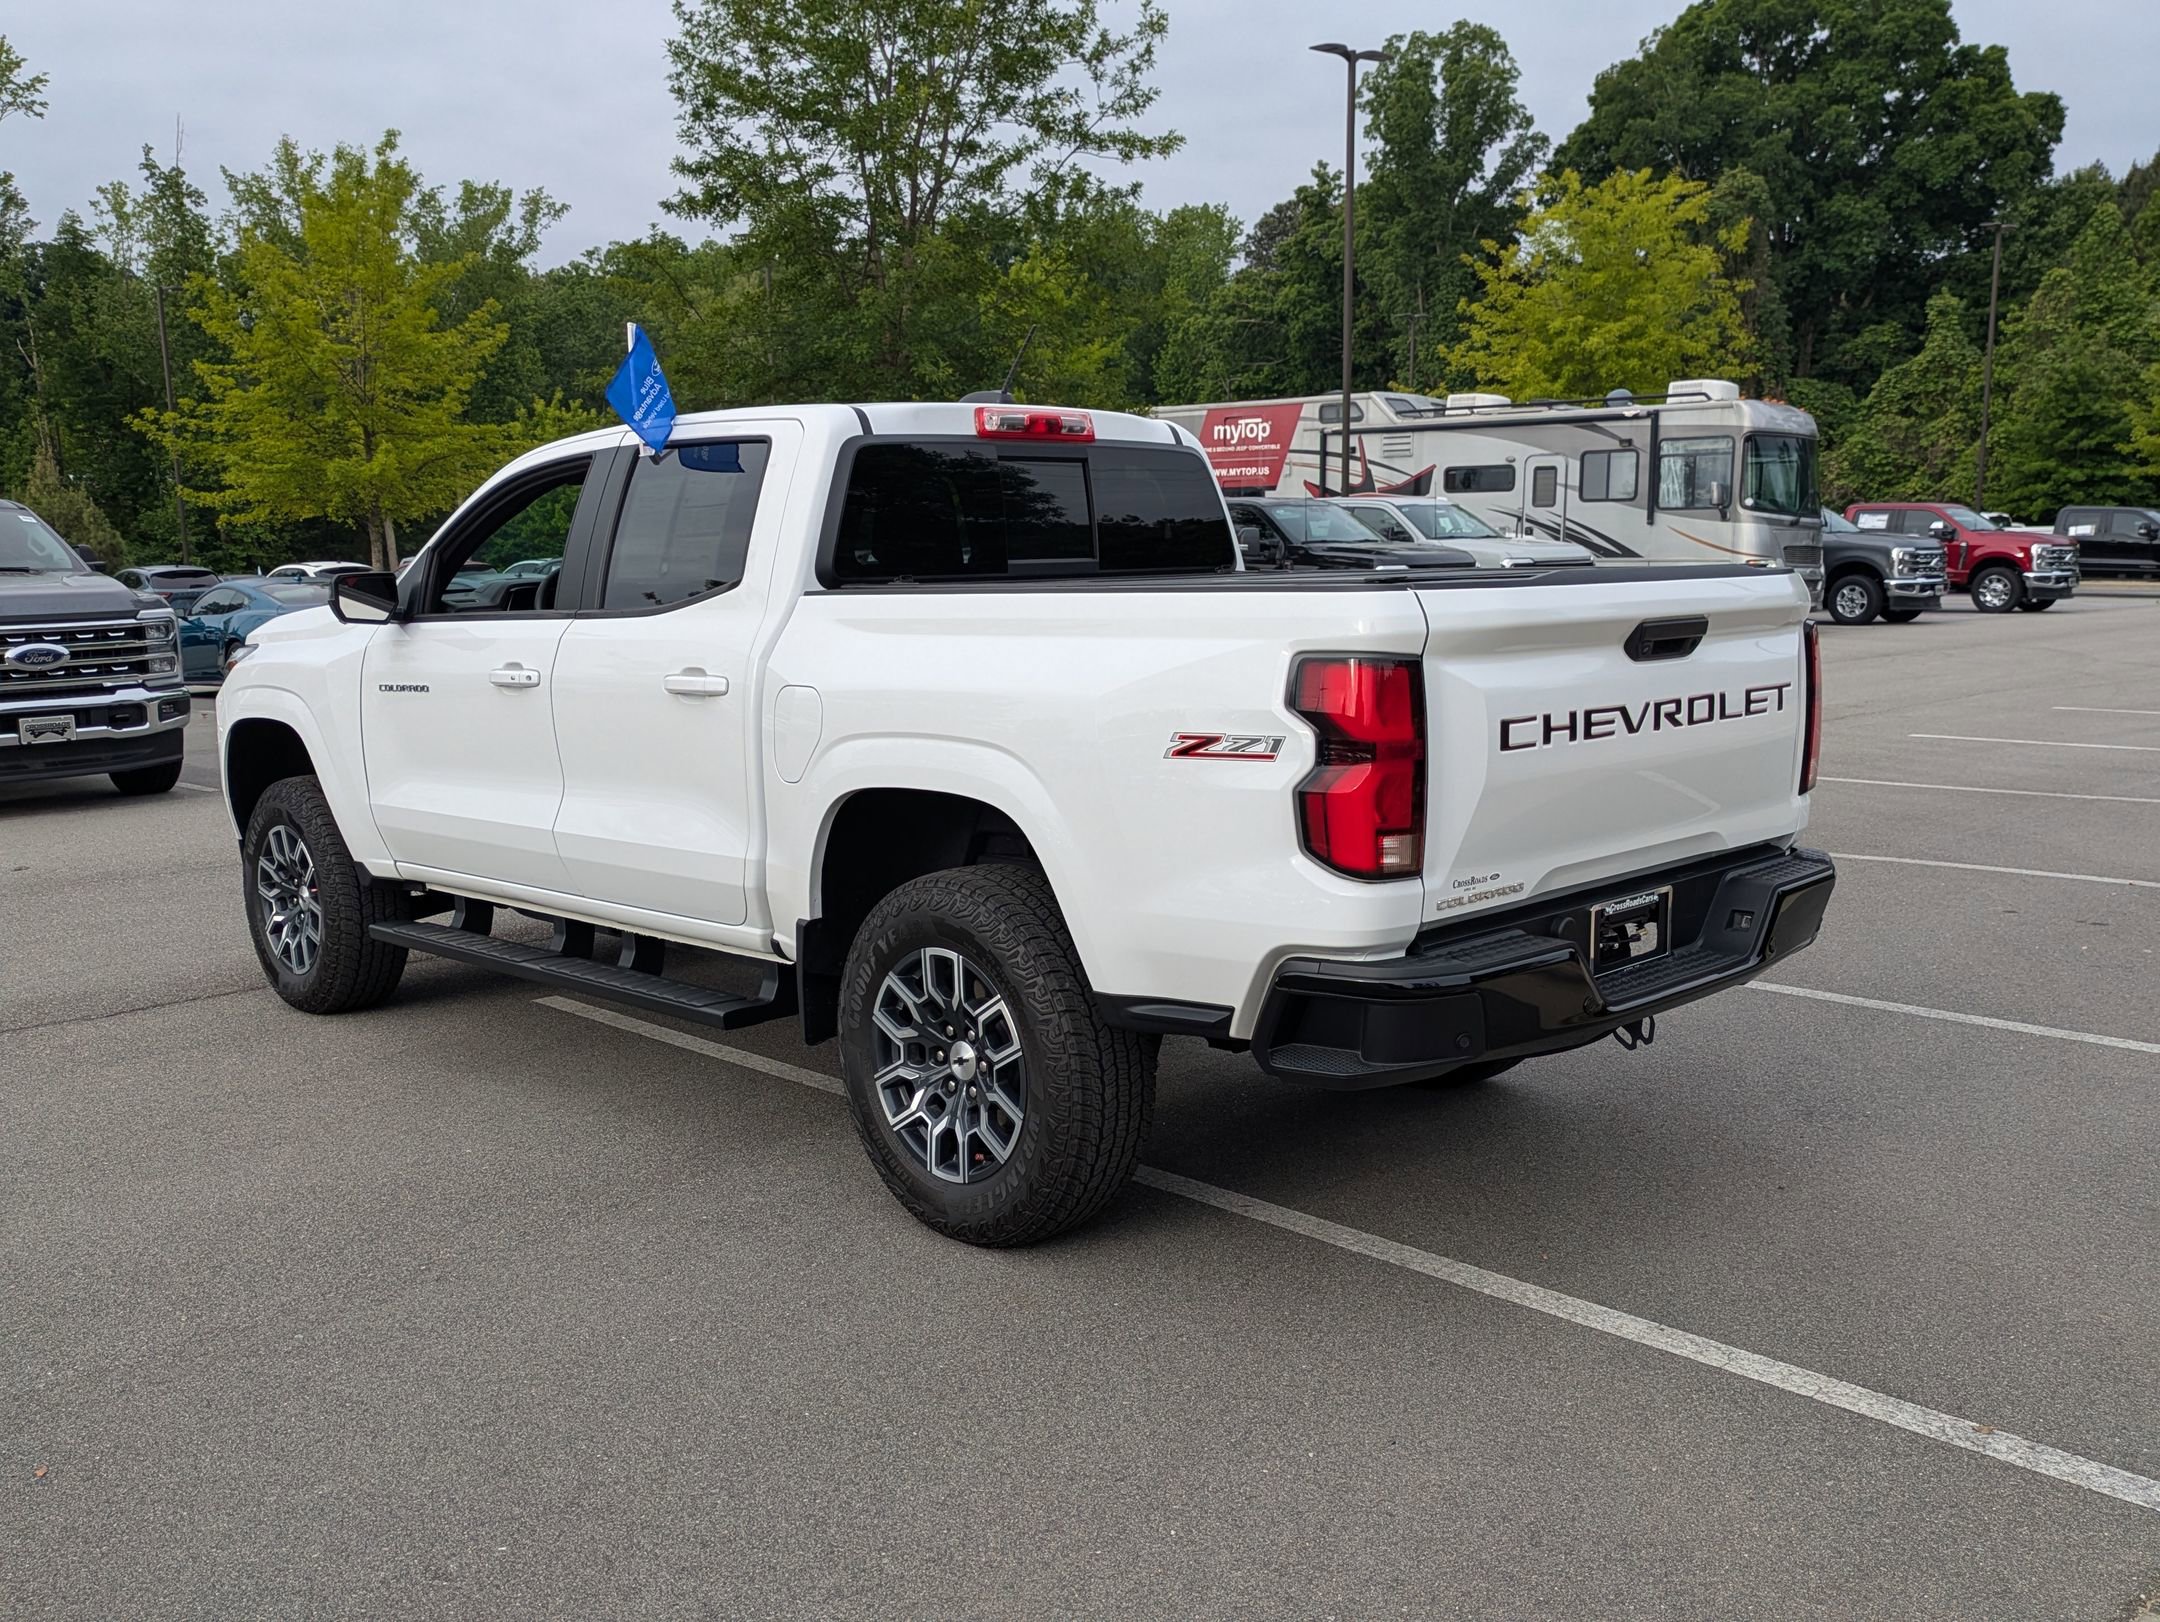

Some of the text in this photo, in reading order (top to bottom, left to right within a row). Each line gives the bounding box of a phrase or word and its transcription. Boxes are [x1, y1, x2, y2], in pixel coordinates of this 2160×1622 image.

[1214, 466, 1270, 477] WW.MYTOP.US
[24, 650, 54, 663] Ford
[378, 684, 430, 693] COLORADO
[1499, 681, 1792, 752] CHEVROLET
[1163, 731, 1287, 762] Z71
[1436, 882, 1524, 911] COLORADO
